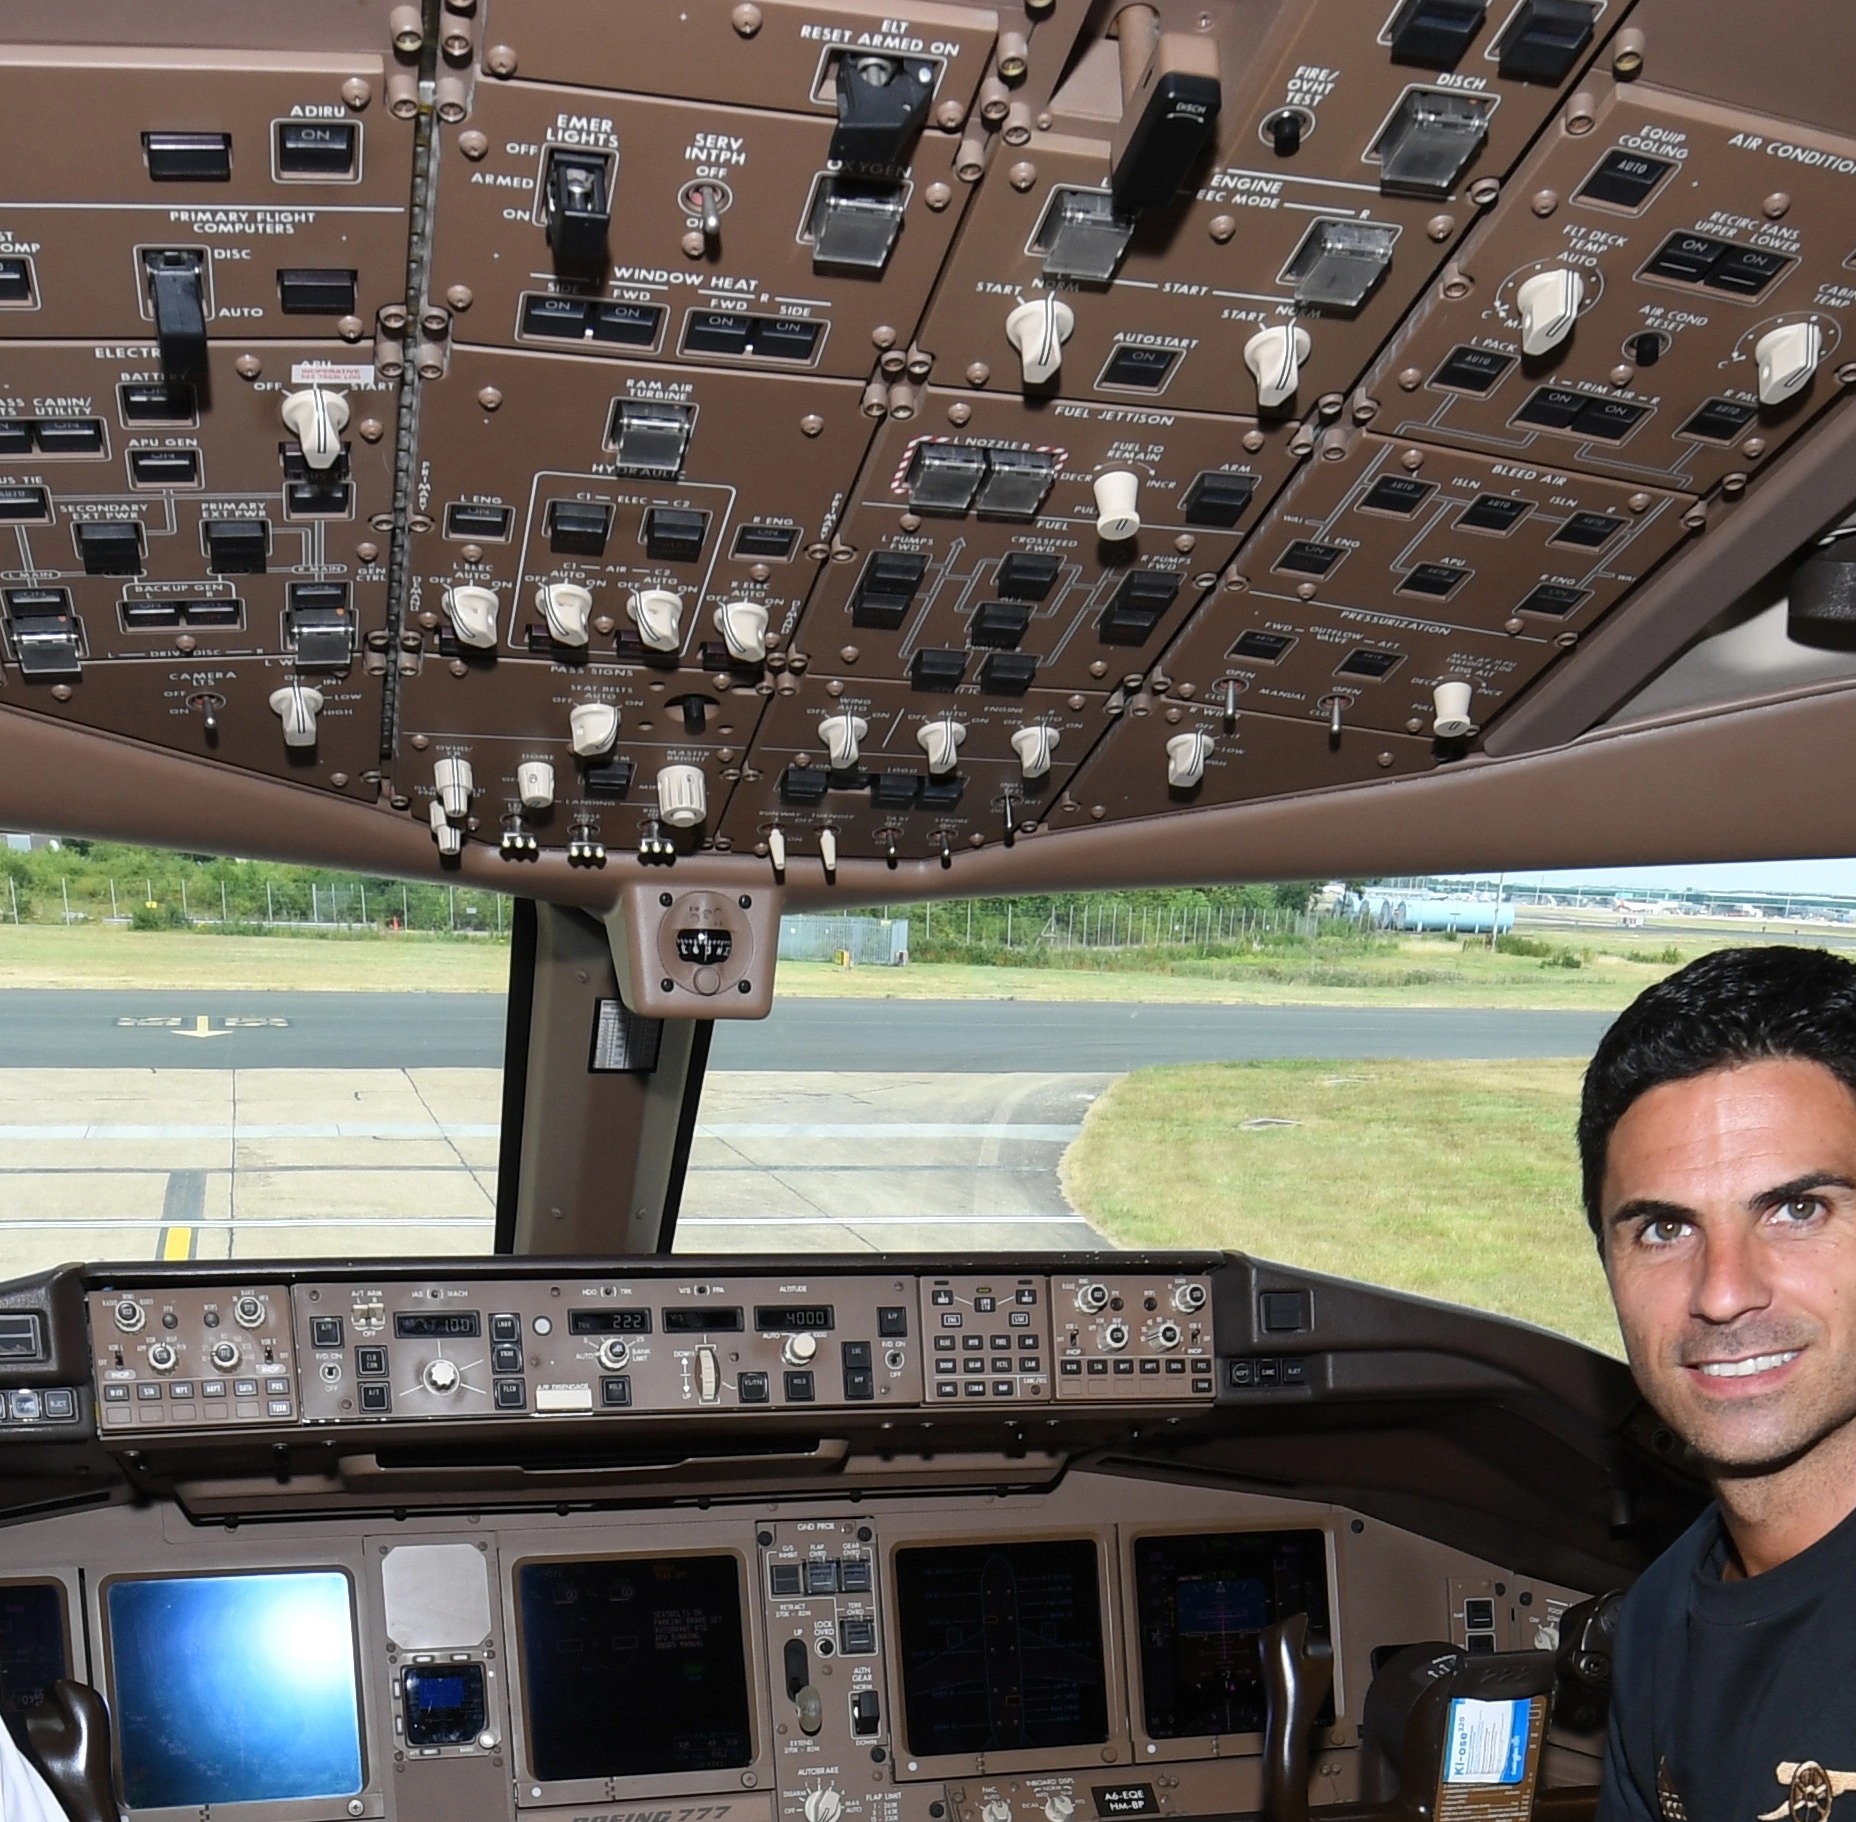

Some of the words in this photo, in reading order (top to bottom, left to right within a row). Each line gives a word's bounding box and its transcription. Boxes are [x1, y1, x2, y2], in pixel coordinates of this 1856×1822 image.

[882, 20, 908, 34] ELT
[800, 25, 852, 44] RESET
[857, 33, 924, 52] ARMED
[930, 43, 959, 56] ON
[1295, 66, 1339, 82] FIRE/
[1288, 78, 1334, 95] OVHT
[1437, 74, 1486, 90] DISCH
[1286, 92, 1322, 106] TEST
[291, 106, 344, 117] ADIRU
[556, 116, 612, 132] EMER
[547, 128, 618, 147] LIGHTS
[694, 134, 744, 150] SERV
[1640, 126, 1686, 144] EQUIP
[1728, 132, 1764, 151] AIR
[506, 143, 538, 156] OFF
[1618, 136, 1688, 160] COOLING
[685, 148, 745, 166] INTPH
[696, 166, 728, 178] OFF
[1617, 160, 1648, 174] AUTO
[472, 174, 534, 188] ARMED
[1210, 174, 1282, 194] ENGINE
[1196, 190, 1226, 203] EEC
[1231, 194, 1280, 208] MODE
[170, 211, 250, 224] PRIMARY
[257, 212, 315, 224] FLIGHT
[503, 209, 530, 222] ON
[194, 222, 294, 235] COMPUTERS
[1709, 211, 1758, 230] RECIRC
[1760, 223, 1800, 240] FANS
[1563, 224, 1588, 239] FLT
[1594, 230, 1629, 248] DECK
[1694, 222, 1738, 238] UPPER
[1750, 234, 1801, 252] LOWER
[1569, 238, 1608, 254] TEMP
[215, 249, 252, 260] DISC
[1557, 252, 1597, 267] AUTO
[614, 267, 703, 287] WINDOW
[710, 276, 758, 292] HEAT
[613, 288, 650, 302] FWD
[976, 282, 1022, 296] START
[1162, 284, 1208, 298] START
[710, 298, 748, 311] FWD
[1814, 294, 1850, 308] TEMP
[219, 307, 262, 318] AUTO
[780, 304, 812, 317] SIDE
[1222, 310, 1267, 323] START
[1639, 304, 1663, 318] AIR
[1669, 310, 1708, 328] COND
[1645, 318, 1686, 333] RESET
[1114, 332, 1198, 350] AUTOSTART
[1484, 338, 1519, 353] PACK
[1576, 381, 1608, 394] TRIM
[1610, 388, 1636, 400] AIR
[34, 397, 91, 409] CABIN/
[36, 406, 92, 416] UTILITY
[1055, 407, 1093, 421] FUEL
[1097, 411, 1175, 427] JETTISON
[1113, 442, 1144, 453] FUEL
[1149, 444, 1164, 454] TO
[1107, 450, 1161, 463] REMAIN
[1221, 463, 1252, 473] ARM
[1491, 464, 1537, 481] BLEED
[1538, 474, 1566, 487] AIR
[1340, 610, 1451, 637] PRESSURIZATION
[613, 1315, 641, 1328] 222
[786, 1312, 824, 1325] 4000
[797, 1767, 839, 1775] AUTOBRAKE
[1104, 1790, 1144, 1802] A6-EQE
[1109, 1800, 1144, 1812] HM-BP
[676, 1806, 732, 1822] 777
